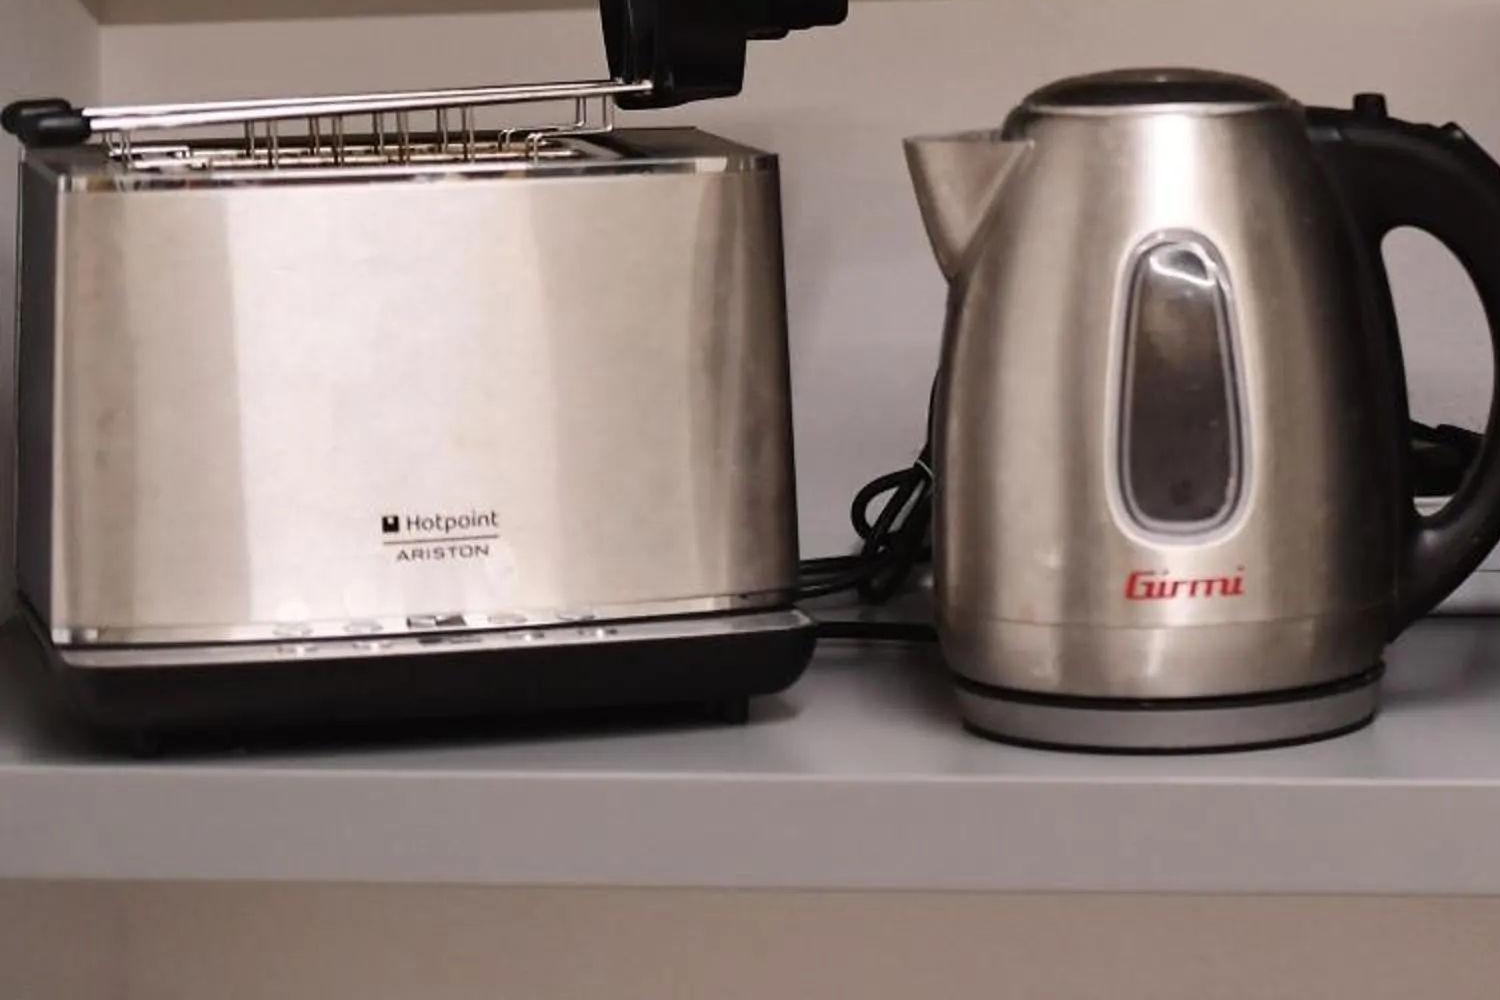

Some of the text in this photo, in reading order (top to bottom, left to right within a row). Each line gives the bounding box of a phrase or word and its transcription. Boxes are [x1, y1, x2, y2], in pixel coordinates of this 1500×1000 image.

[406, 510, 499, 533] Hotpoint
[397, 544, 489, 562] ARISTON
[1125, 565, 1246, 601] Girmi
